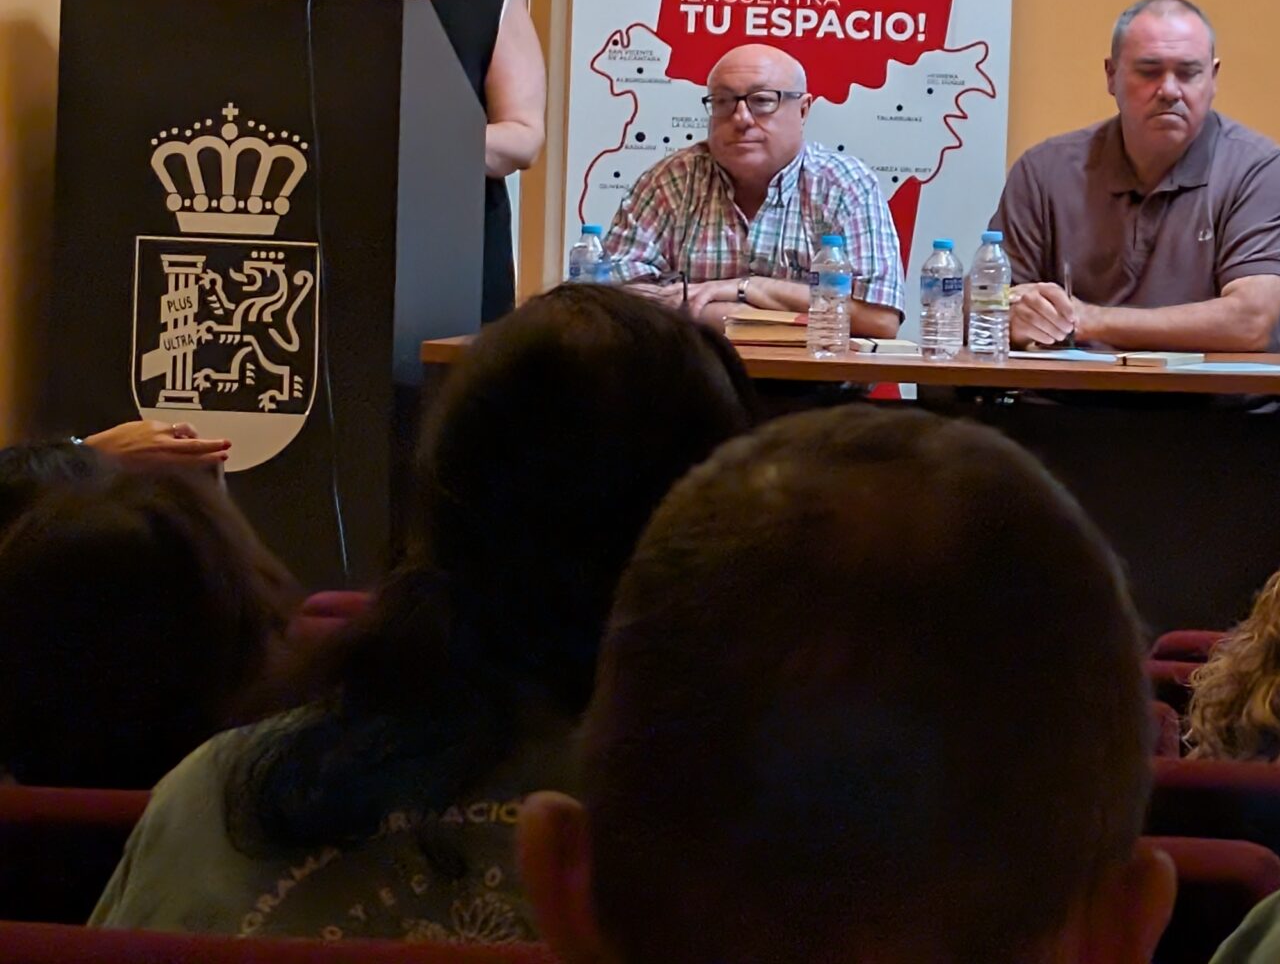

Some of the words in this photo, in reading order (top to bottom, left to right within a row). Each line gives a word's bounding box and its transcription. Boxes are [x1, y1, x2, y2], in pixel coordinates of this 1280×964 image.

[679, 3, 732, 35] TU
[745, 6, 927, 42] ESPACIO!
[167, 296, 193, 313] PLUS
[164, 334, 194, 351] ULTRA
